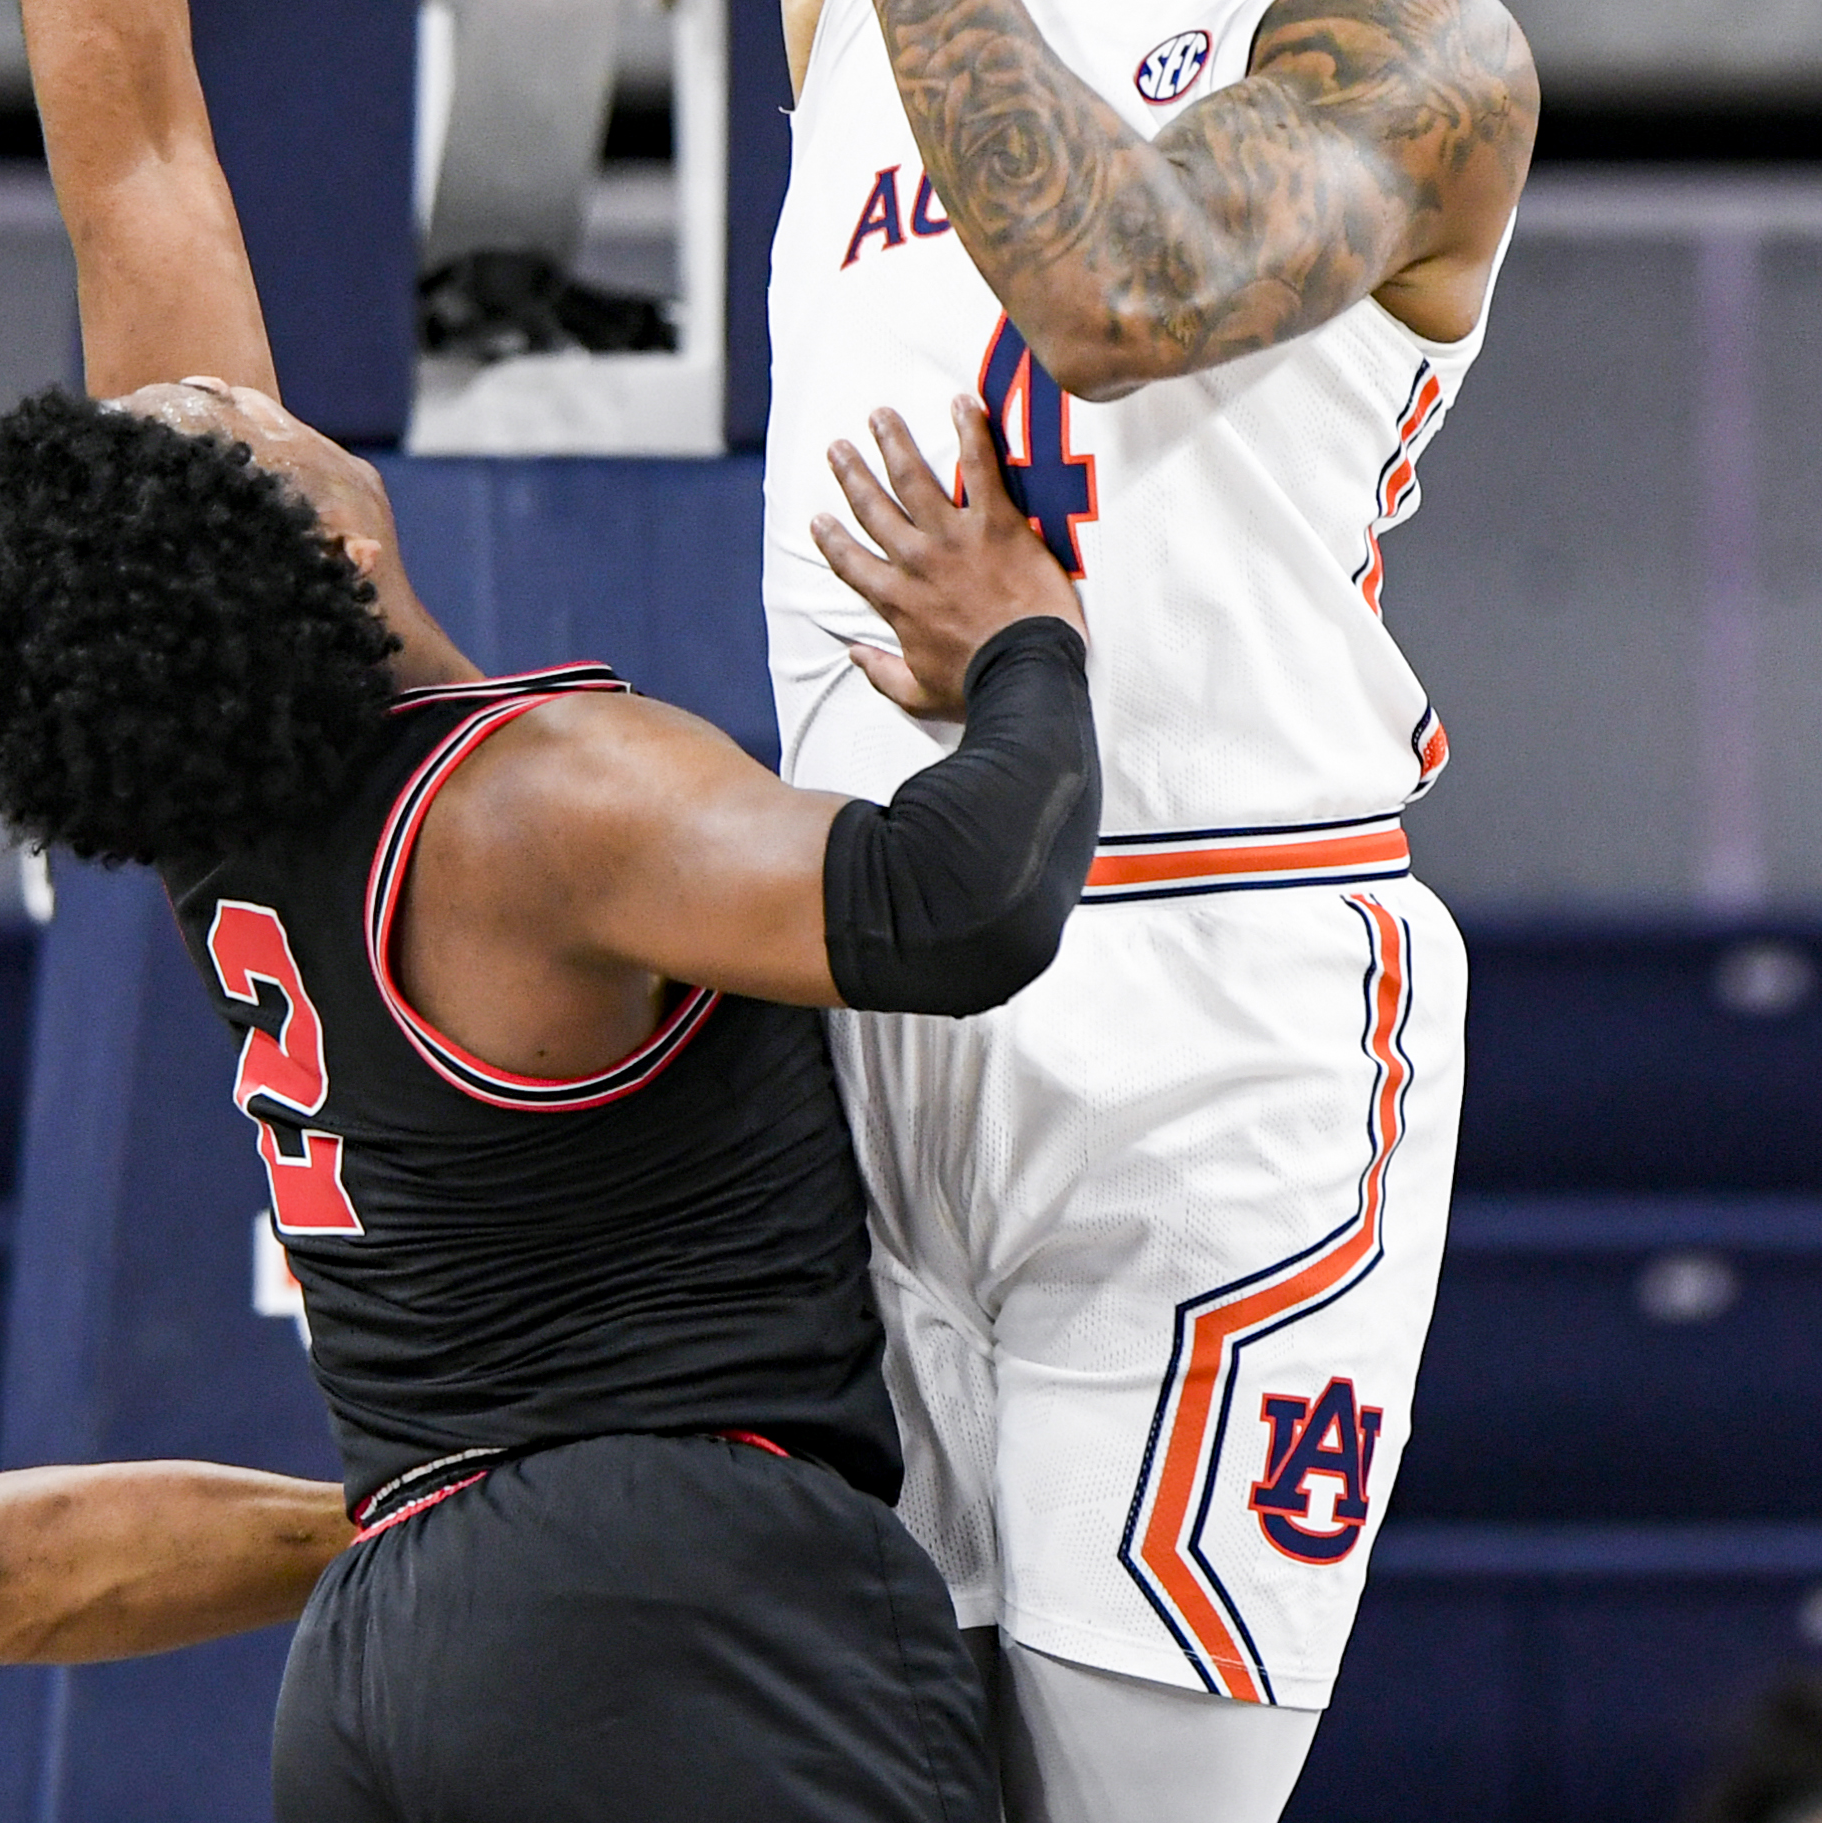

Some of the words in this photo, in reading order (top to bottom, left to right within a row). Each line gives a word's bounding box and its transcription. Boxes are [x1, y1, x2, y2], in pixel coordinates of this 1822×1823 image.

[1137, 31, 1207, 100] SEC
[953, 309, 1098, 579] 4
[207, 898, 365, 1236] 2
